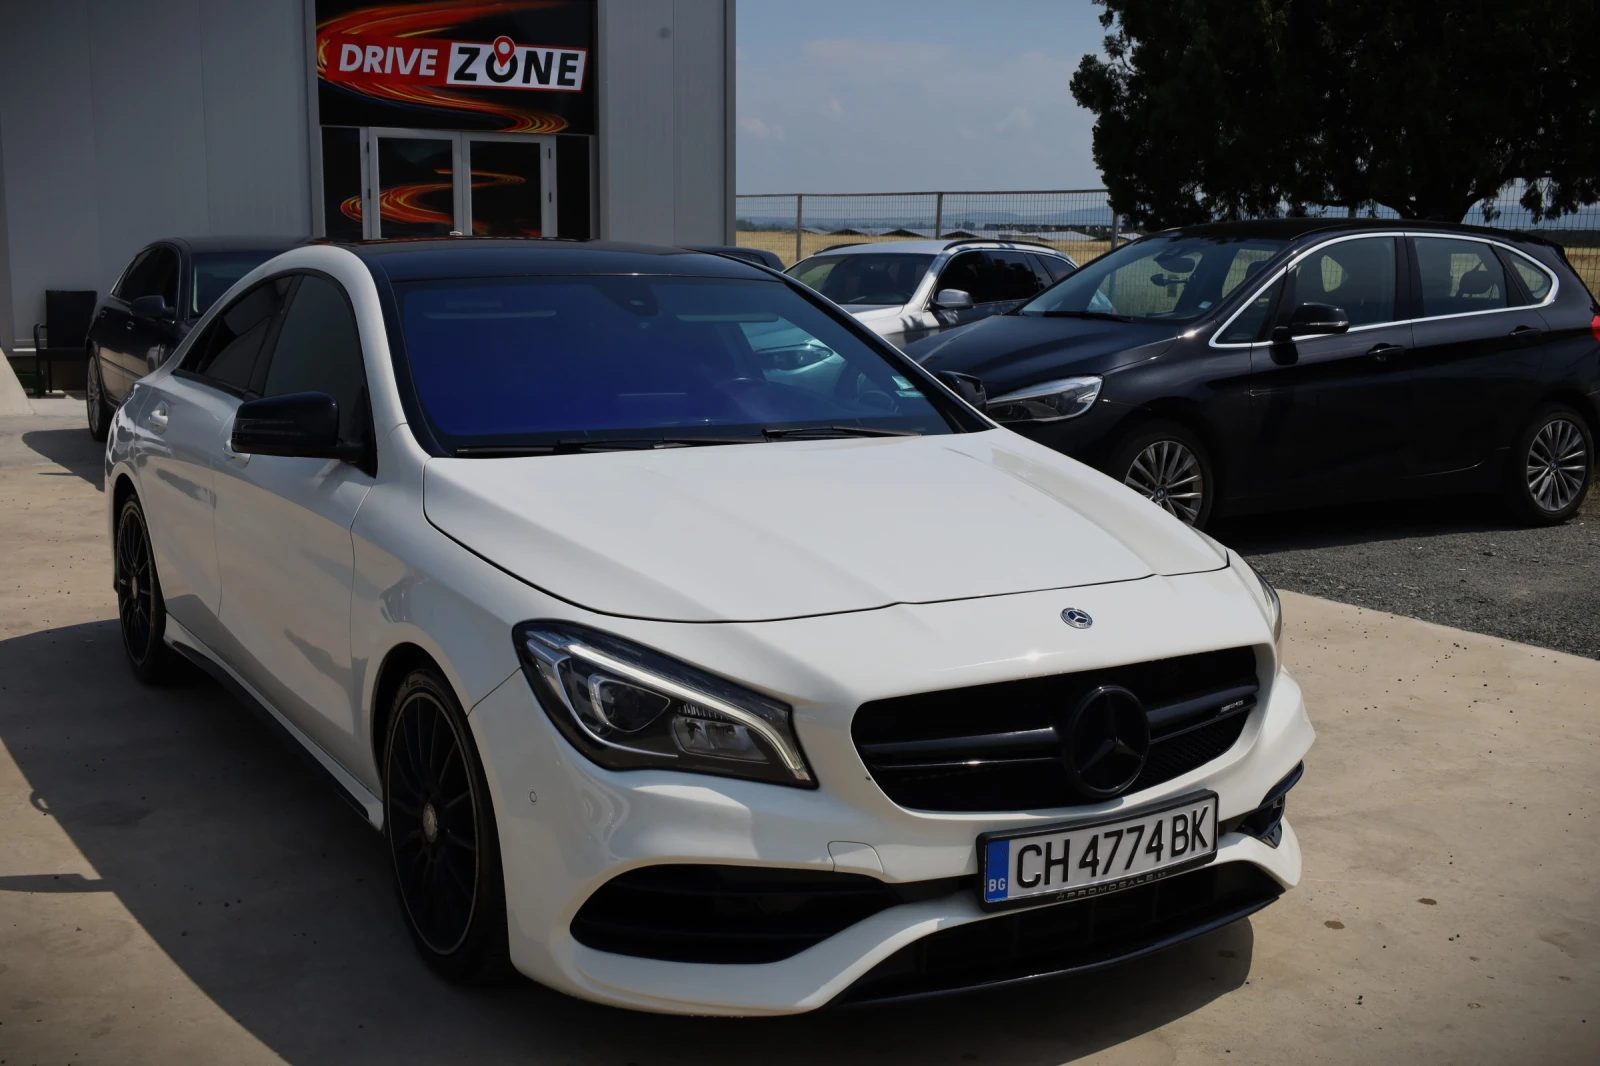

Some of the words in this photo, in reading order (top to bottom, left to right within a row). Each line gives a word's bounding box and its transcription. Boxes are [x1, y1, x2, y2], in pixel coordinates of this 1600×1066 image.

[339, 43, 438, 76] DRIVE
[453, 46, 579, 87] ZONE
[1016, 838, 1070, 889] CH
[1079, 819, 1164, 877] 4774
[1170, 806, 1209, 858] BK
[988, 877, 1006, 893] BG
